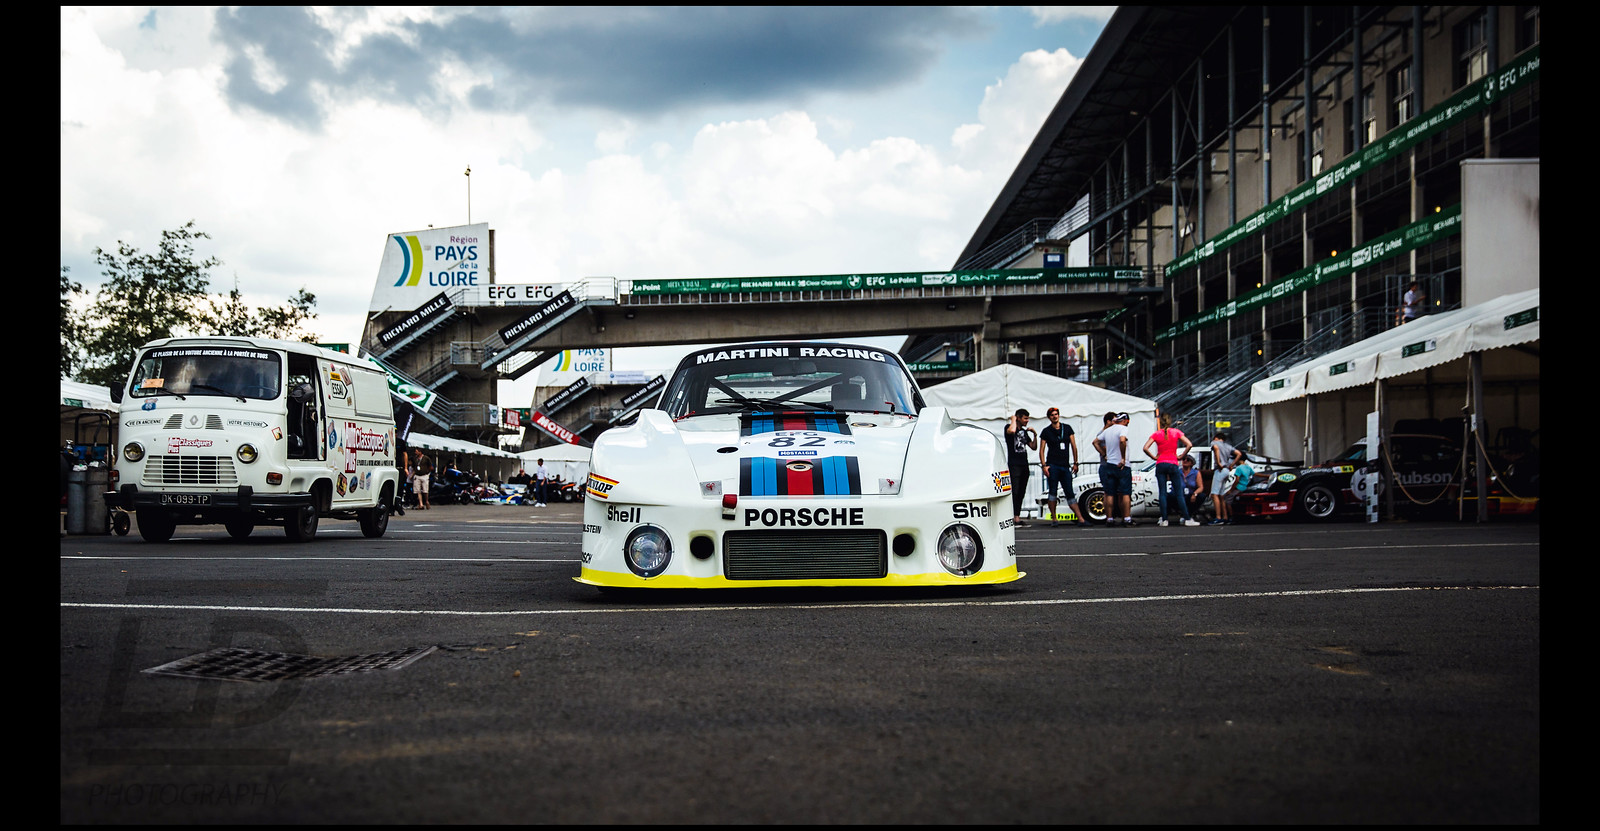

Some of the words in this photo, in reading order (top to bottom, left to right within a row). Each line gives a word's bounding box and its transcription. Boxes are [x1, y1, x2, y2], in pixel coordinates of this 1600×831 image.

[1500, 68, 1516, 91] EFG
[1334, 166, 1346, 183] EFG
[450, 236, 478, 247] Région
[435, 246, 478, 260] PAYS
[1373, 242, 1384, 258] EFG
[460, 262, 468, 270] de
[470, 262, 478, 270] la
[429, 272, 478, 286] LOIRE
[866, 276, 886, 286] EFG
[898, 276, 917, 284] Point
[488, 286, 516, 299] EFG
[526, 286, 554, 298] EFG
[383, 312, 420, 342] RICHARD
[419, 297, 446, 318] MILLE
[504, 310, 542, 340] RICHARD
[542, 295, 568, 316] MILLE
[234, 350, 250, 358] PORTÉE
[696, 348, 789, 364] MARTINI
[800, 347, 886, 362] RACING
[574, 362, 604, 372] LOIRE
[546, 391, 570, 408] RICHARD
[569, 380, 585, 393] MILLE
[624, 388, 648, 404] RICHARD
[647, 378, 663, 390] MILLE
[537, 416, 574, 443] MOTUL
[179, 439, 213, 448] Classiques
[356, 428, 384, 455] Classiques
[768, 437, 826, 447] 82
[1392, 471, 1452, 484] Rubson
[162, 494, 208, 504] DK-099-TP
[607, 505, 641, 523] Shell
[745, 508, 864, 526] PORSCHE
[952, 502, 991, 518] Shell
